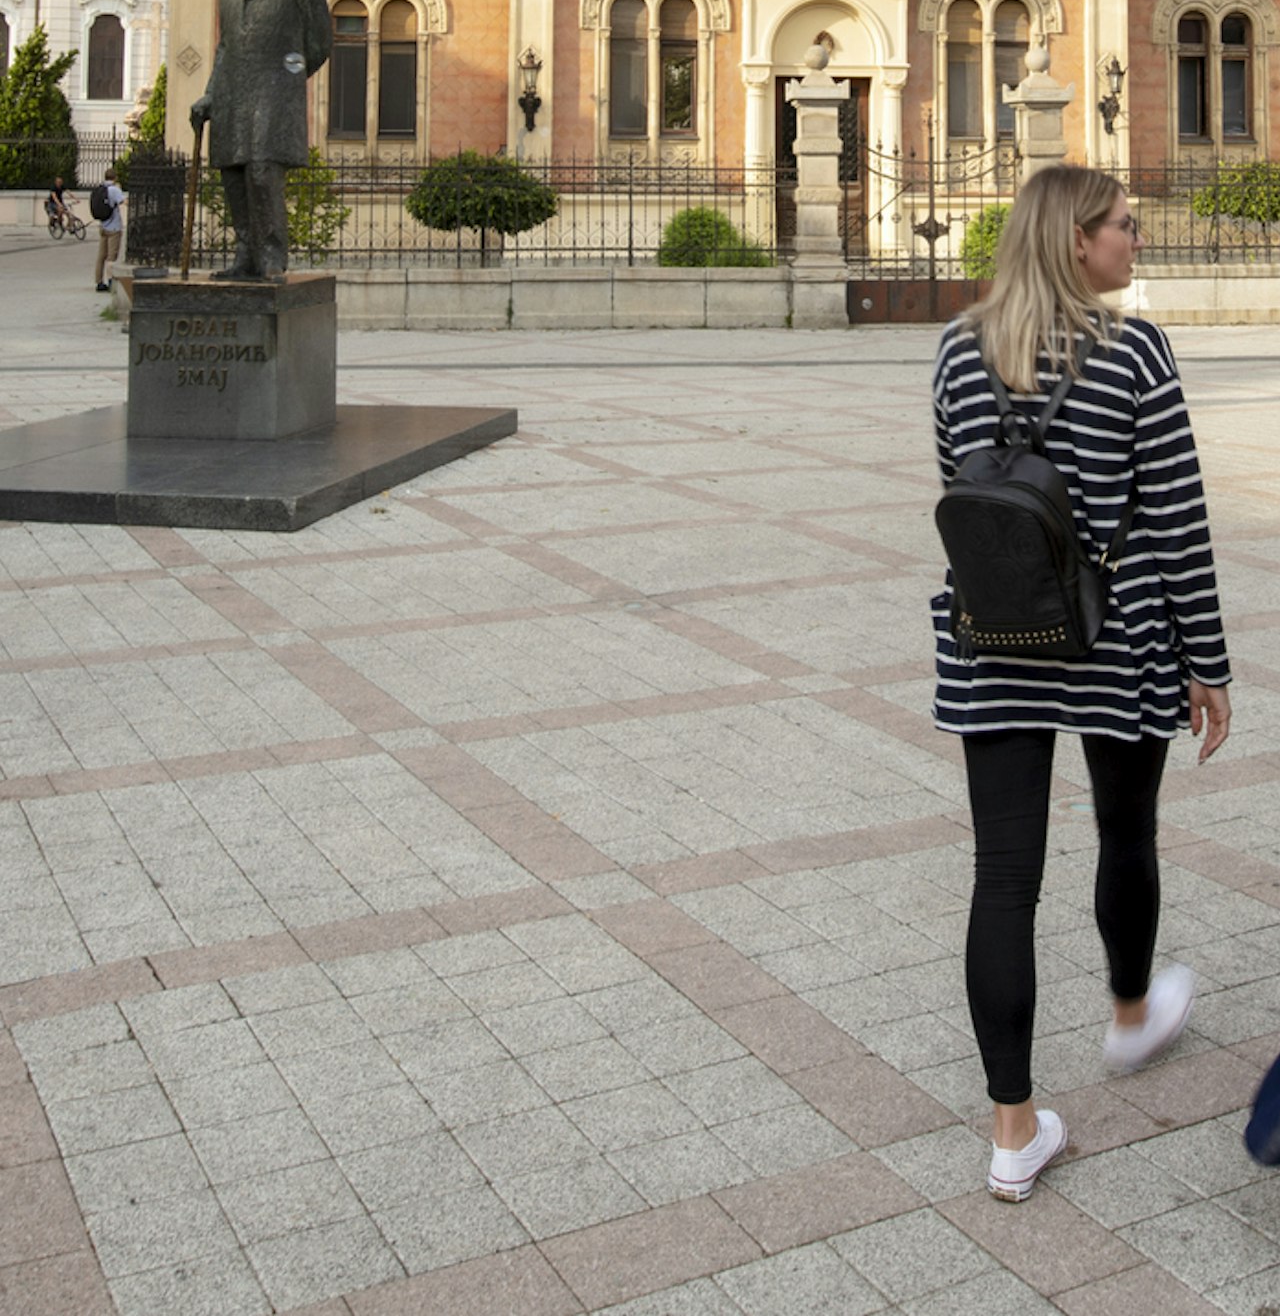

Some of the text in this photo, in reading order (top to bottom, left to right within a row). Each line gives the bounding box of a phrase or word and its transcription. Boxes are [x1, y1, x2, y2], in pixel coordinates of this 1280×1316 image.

[165, 317, 238, 341] ЈОВАН
[135, 343, 268, 365] ЈОВАНОВИЋ
[177, 366, 229, 392] ЗМАЈ
